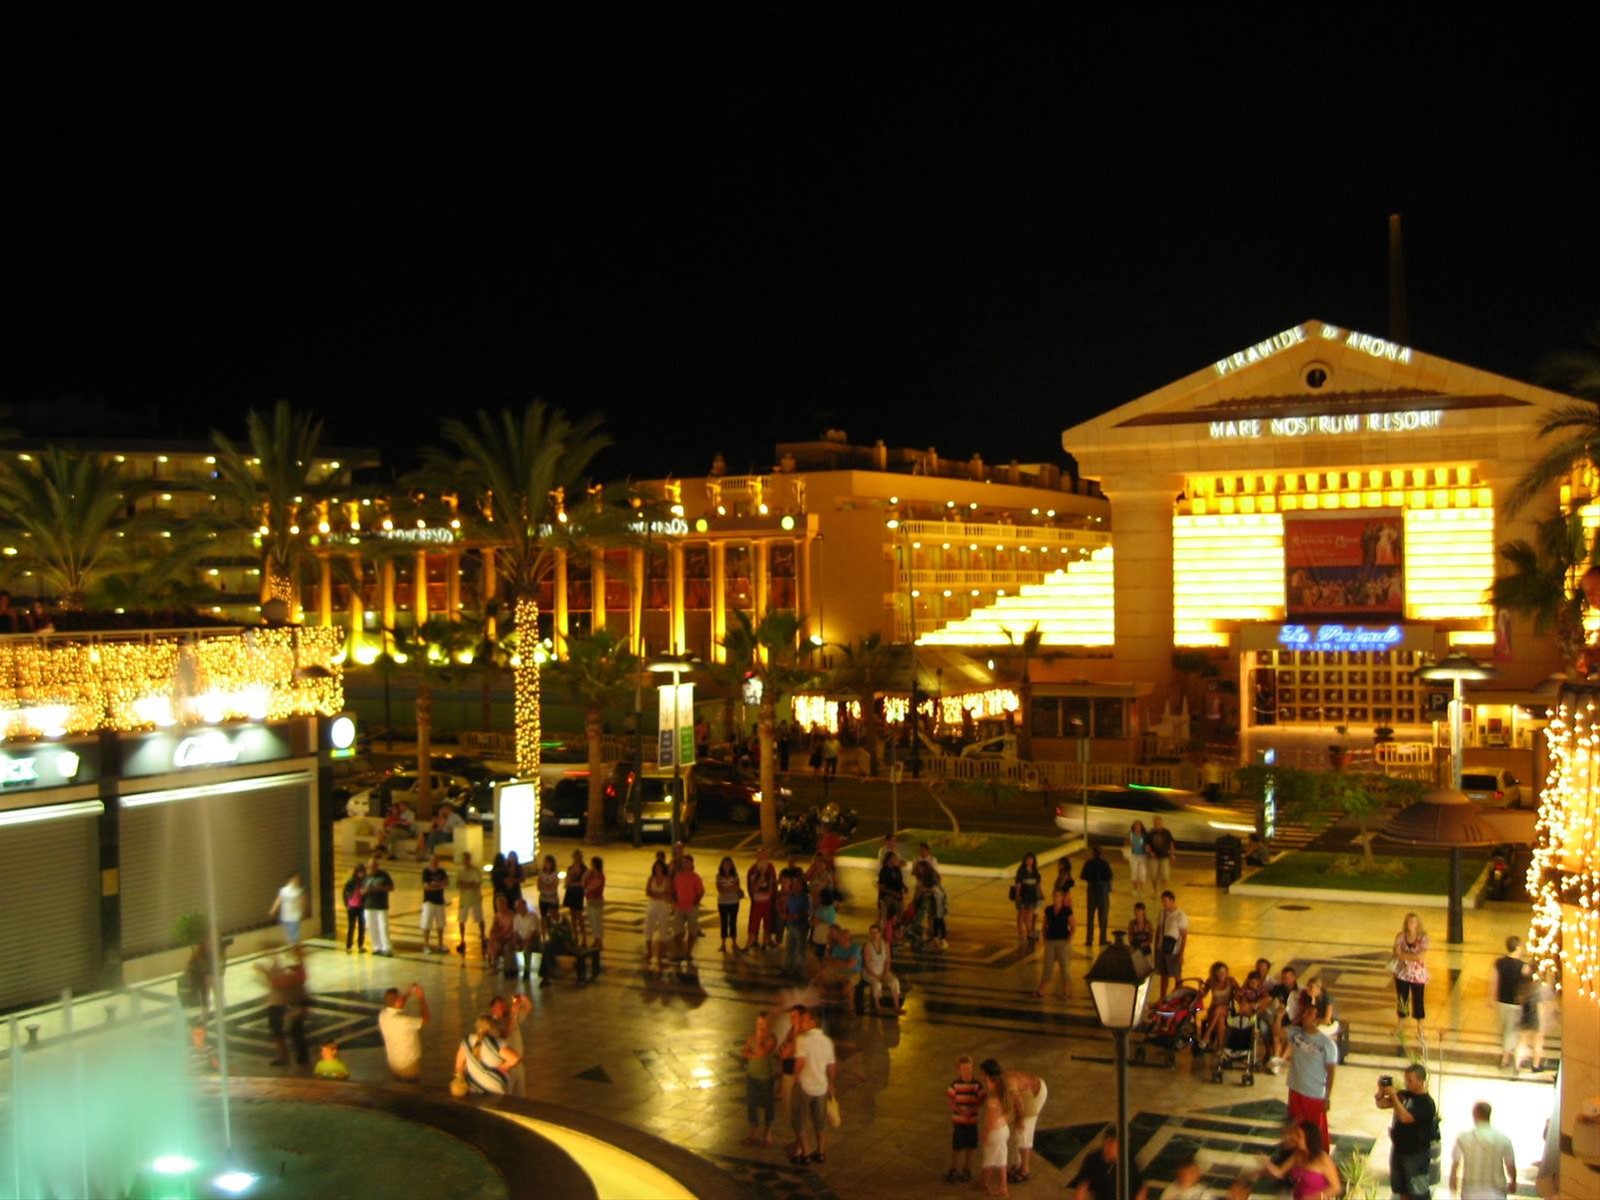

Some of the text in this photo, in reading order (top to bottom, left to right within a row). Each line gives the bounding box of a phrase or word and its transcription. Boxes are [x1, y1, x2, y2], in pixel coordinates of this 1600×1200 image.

[1215, 324, 1307, 376] PIRAMIDE
[1321, 324, 1412, 364] DE ARONA
[1209, 409, 1442, 438] MARE NOSTRUM RESORT
[1432, 694, 1444, 710] P
